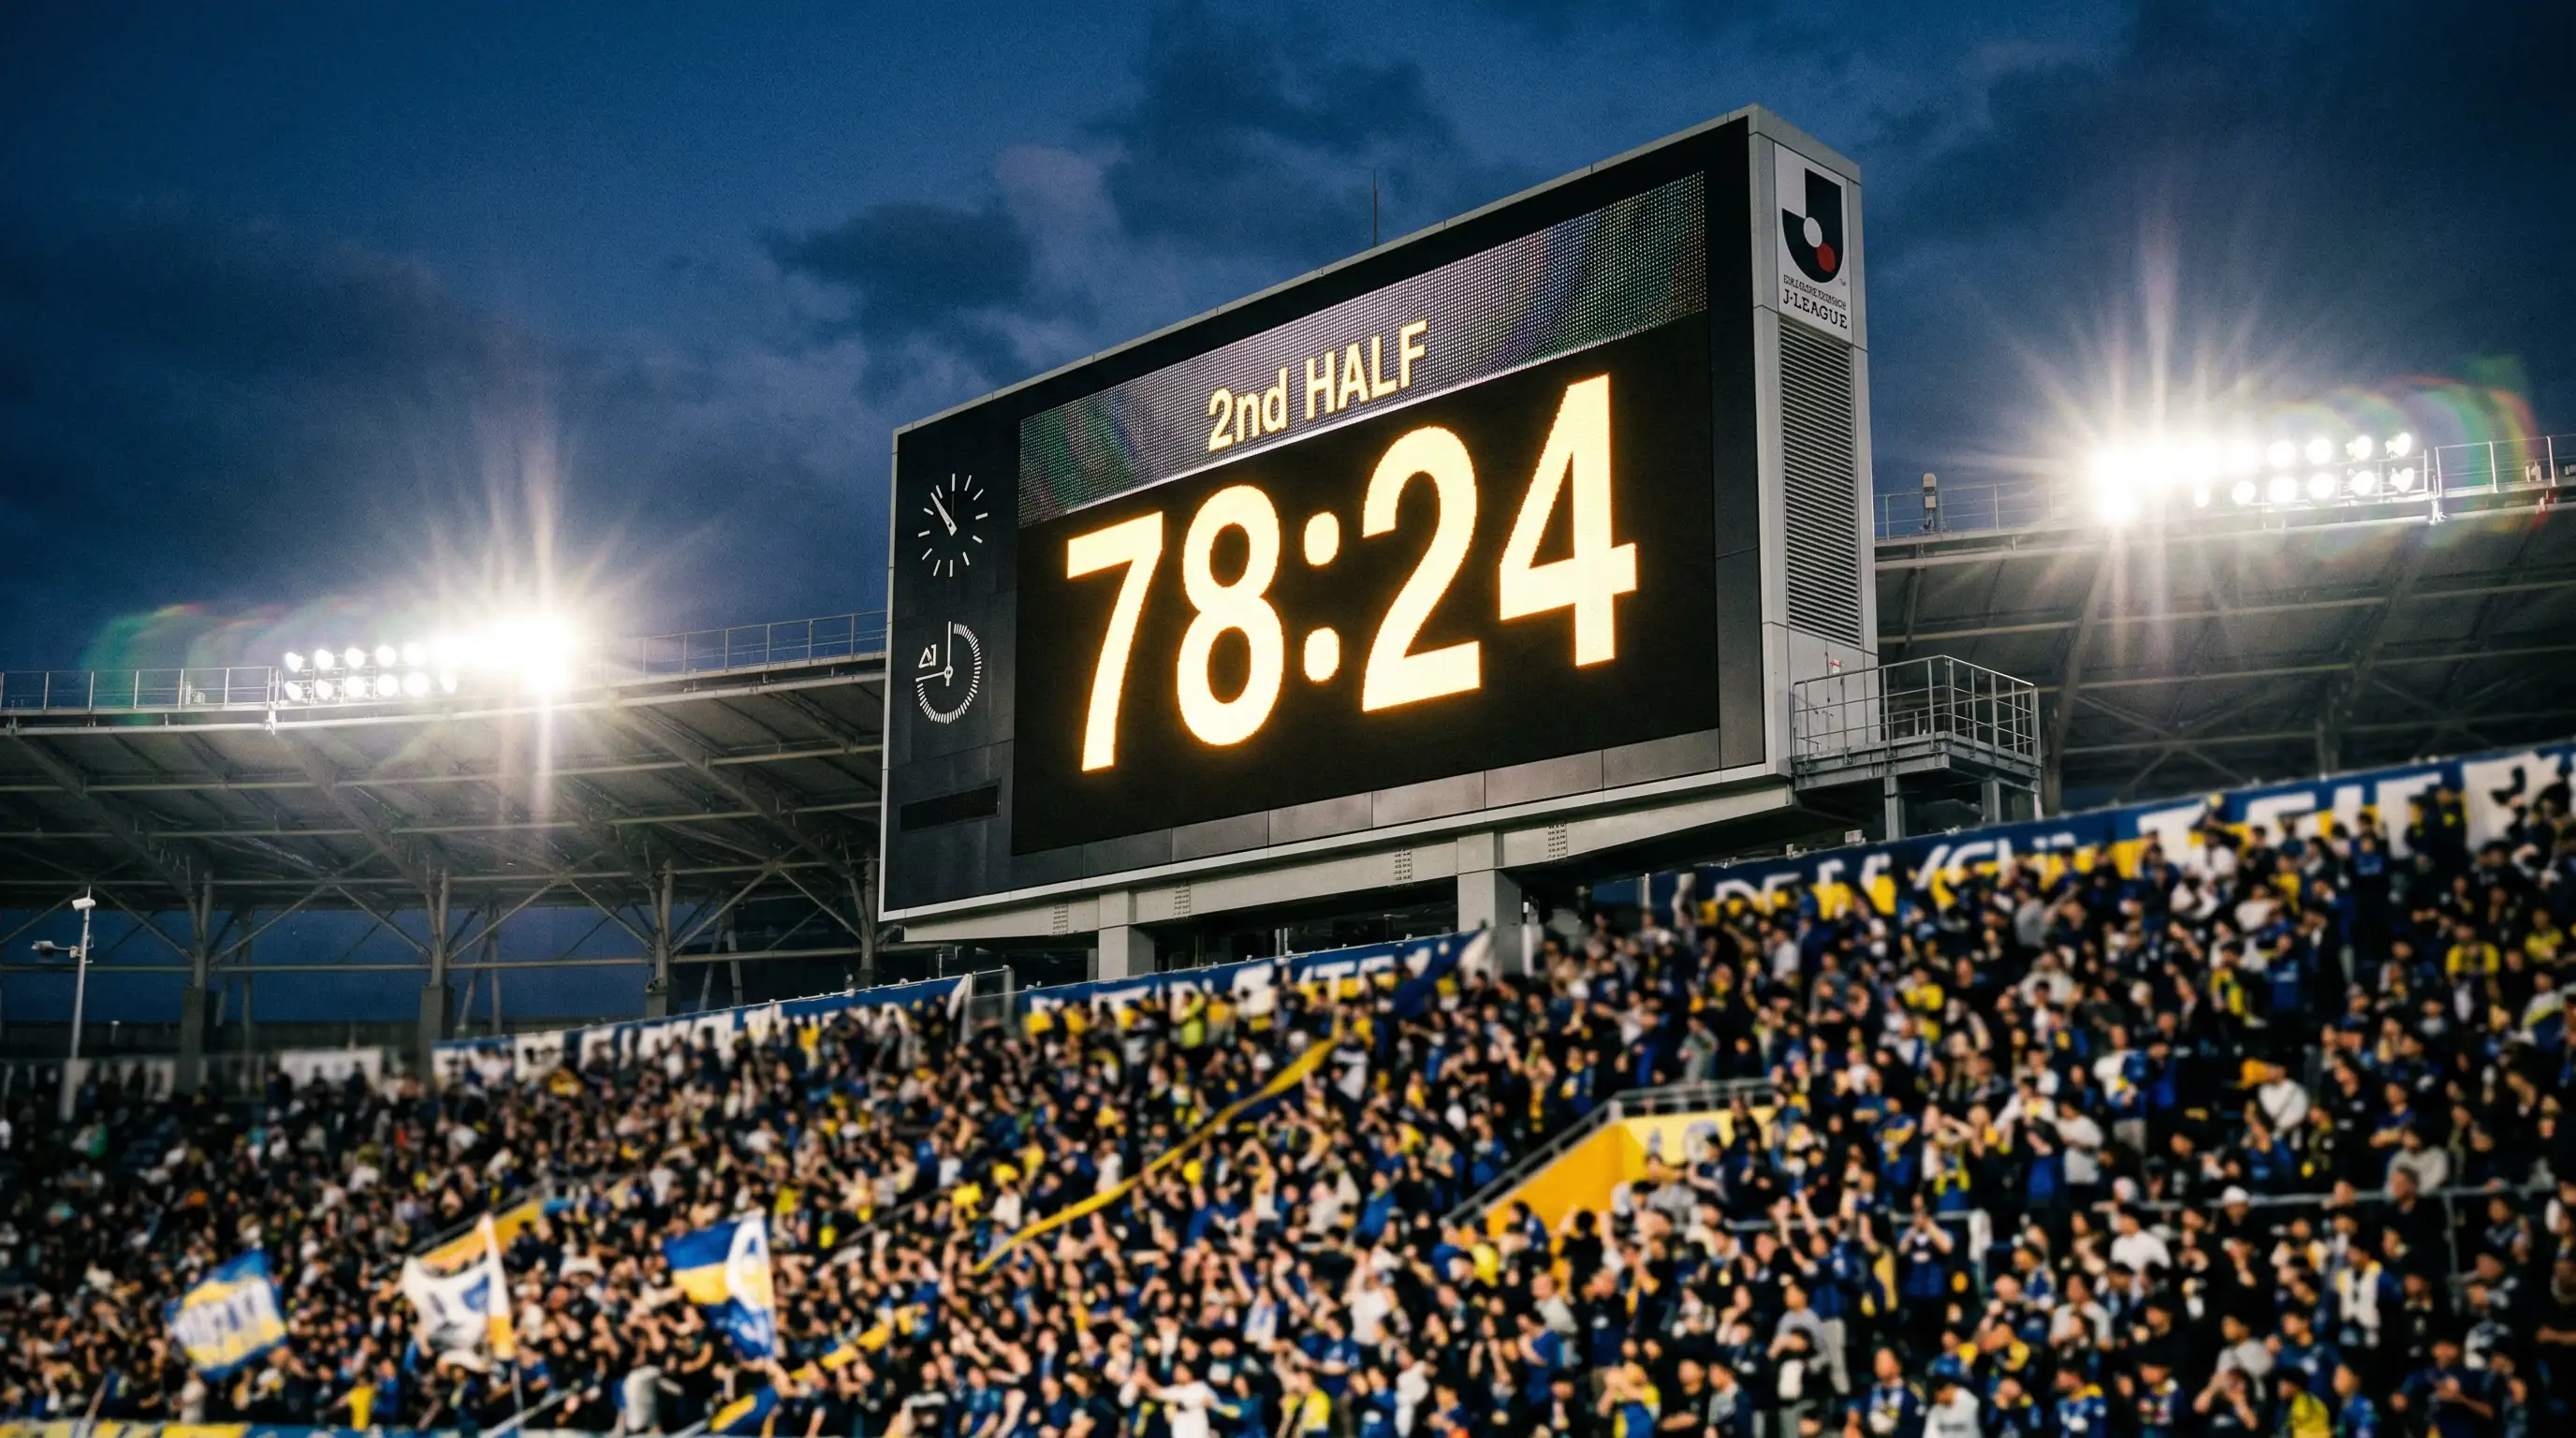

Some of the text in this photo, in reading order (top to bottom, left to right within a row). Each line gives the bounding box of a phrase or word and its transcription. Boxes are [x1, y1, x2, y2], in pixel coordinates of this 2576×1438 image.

[1208, 318, 1428, 452] 2nd HALF
[1066, 374, 1637, 772] 78:24
